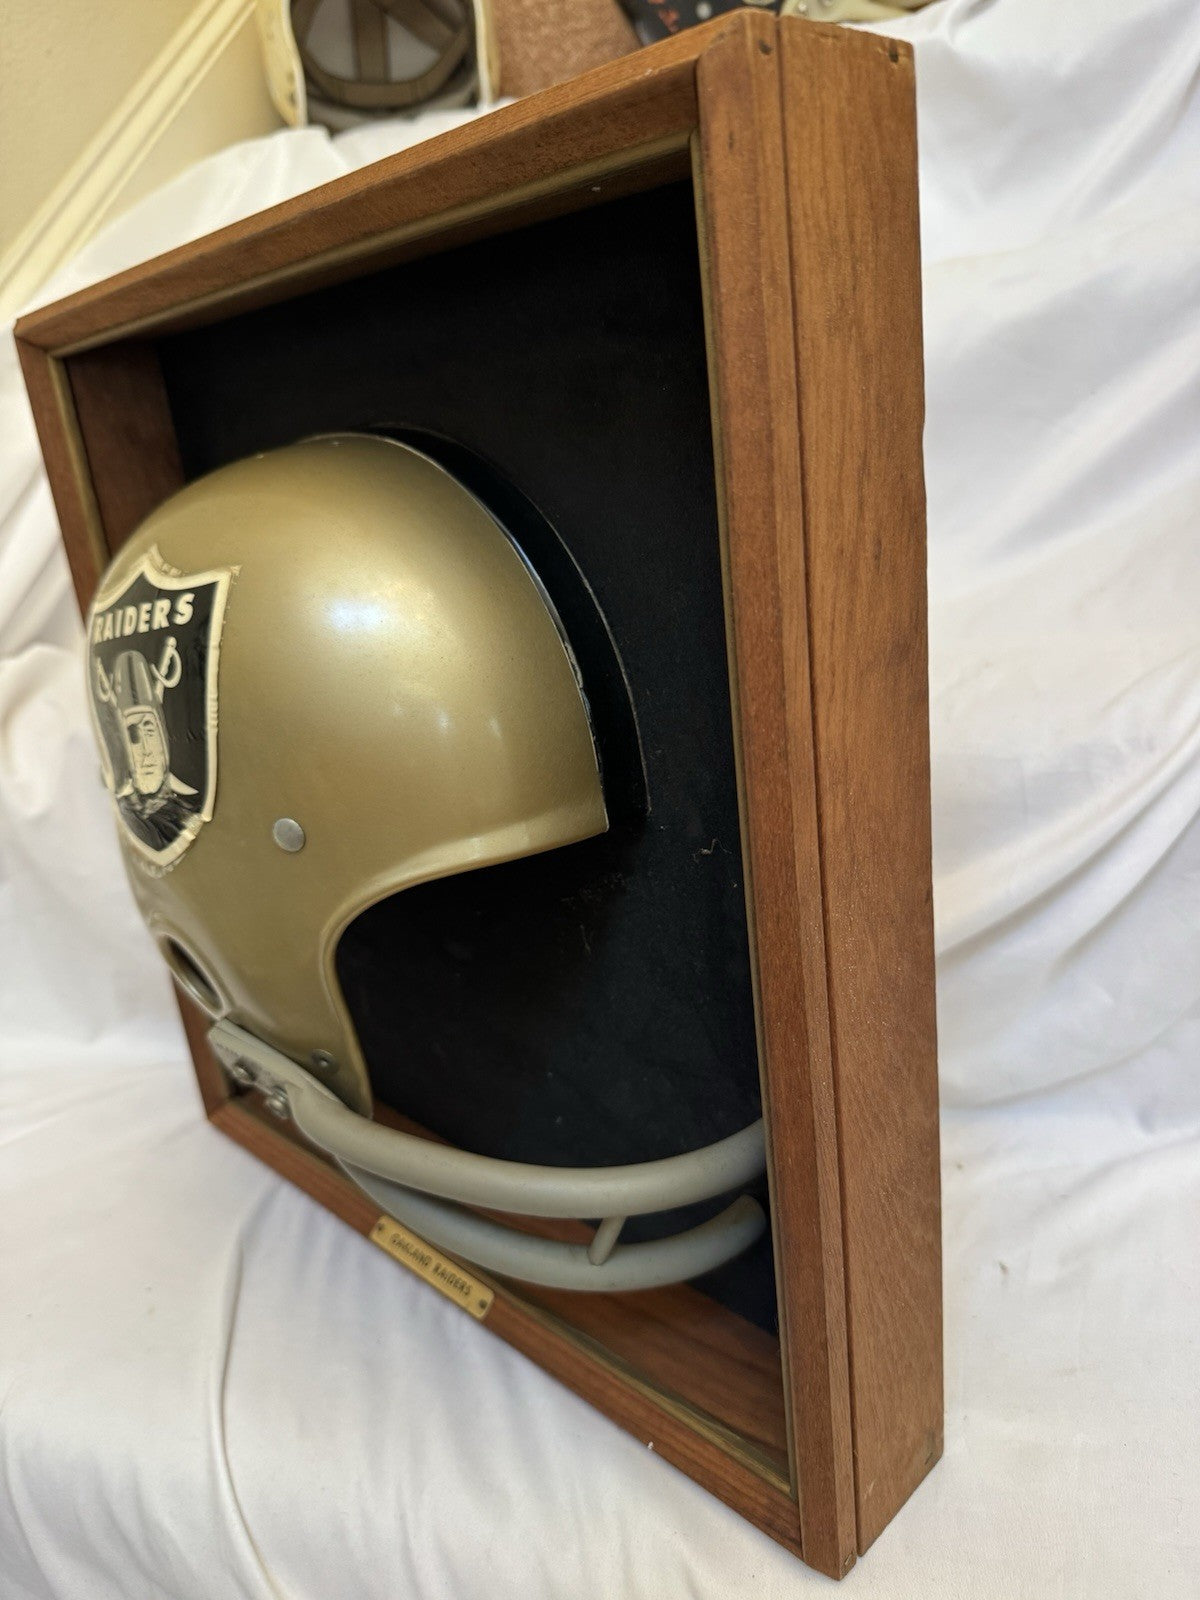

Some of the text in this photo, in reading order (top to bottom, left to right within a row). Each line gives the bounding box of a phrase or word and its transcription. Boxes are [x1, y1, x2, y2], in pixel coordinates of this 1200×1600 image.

[94, 592, 195, 643] RAIDERS
[390, 1233, 472, 1296] OAKLAND RAIDERS
